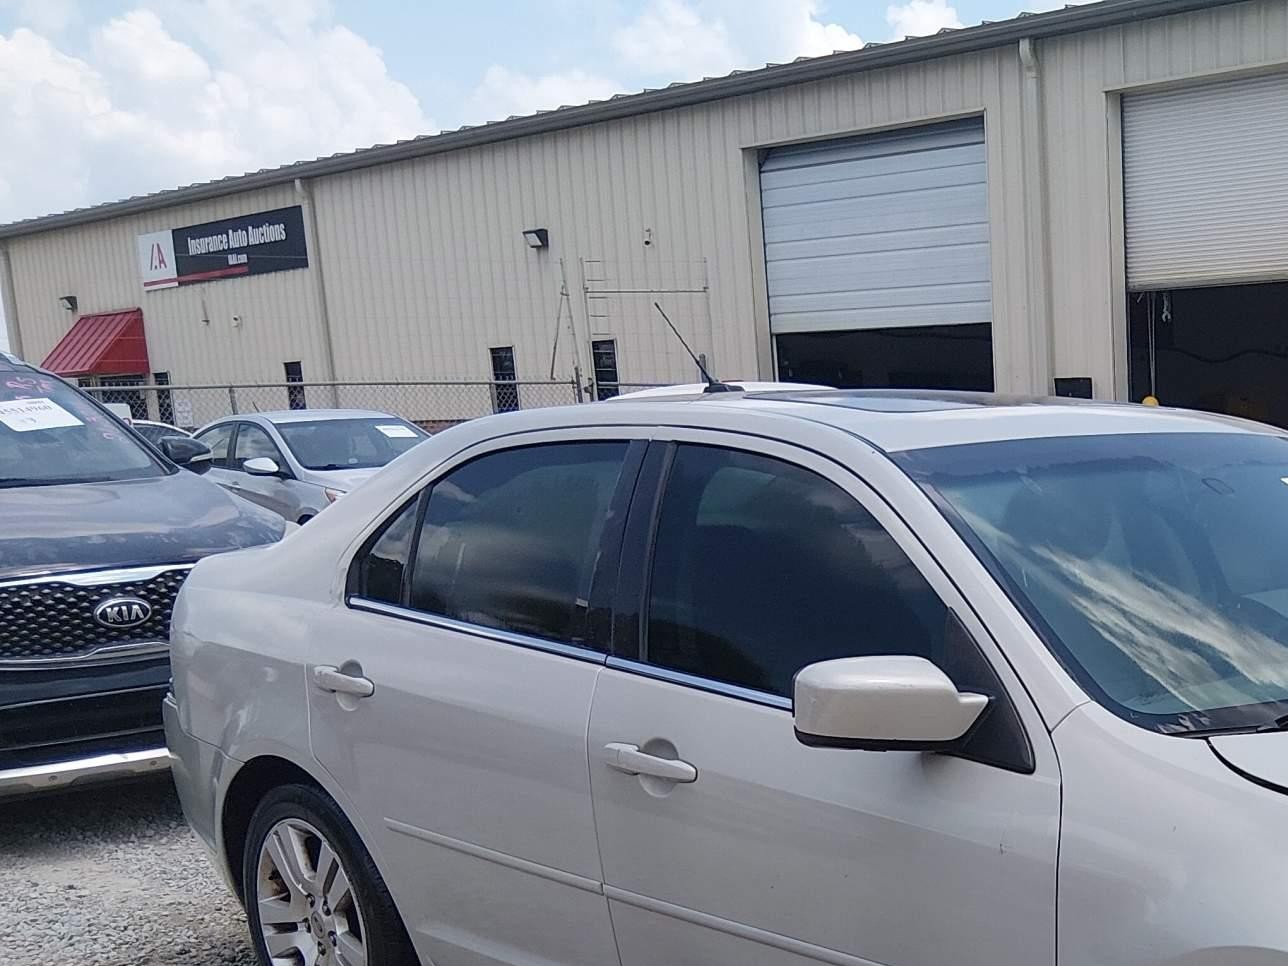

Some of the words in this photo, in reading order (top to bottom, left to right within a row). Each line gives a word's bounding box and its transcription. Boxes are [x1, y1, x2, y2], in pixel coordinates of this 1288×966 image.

[187, 233, 229, 256] Insurance
[228, 228, 248, 249] Auto
[247, 222, 287, 246] Auctions
[105, 604, 145, 622] KIA
